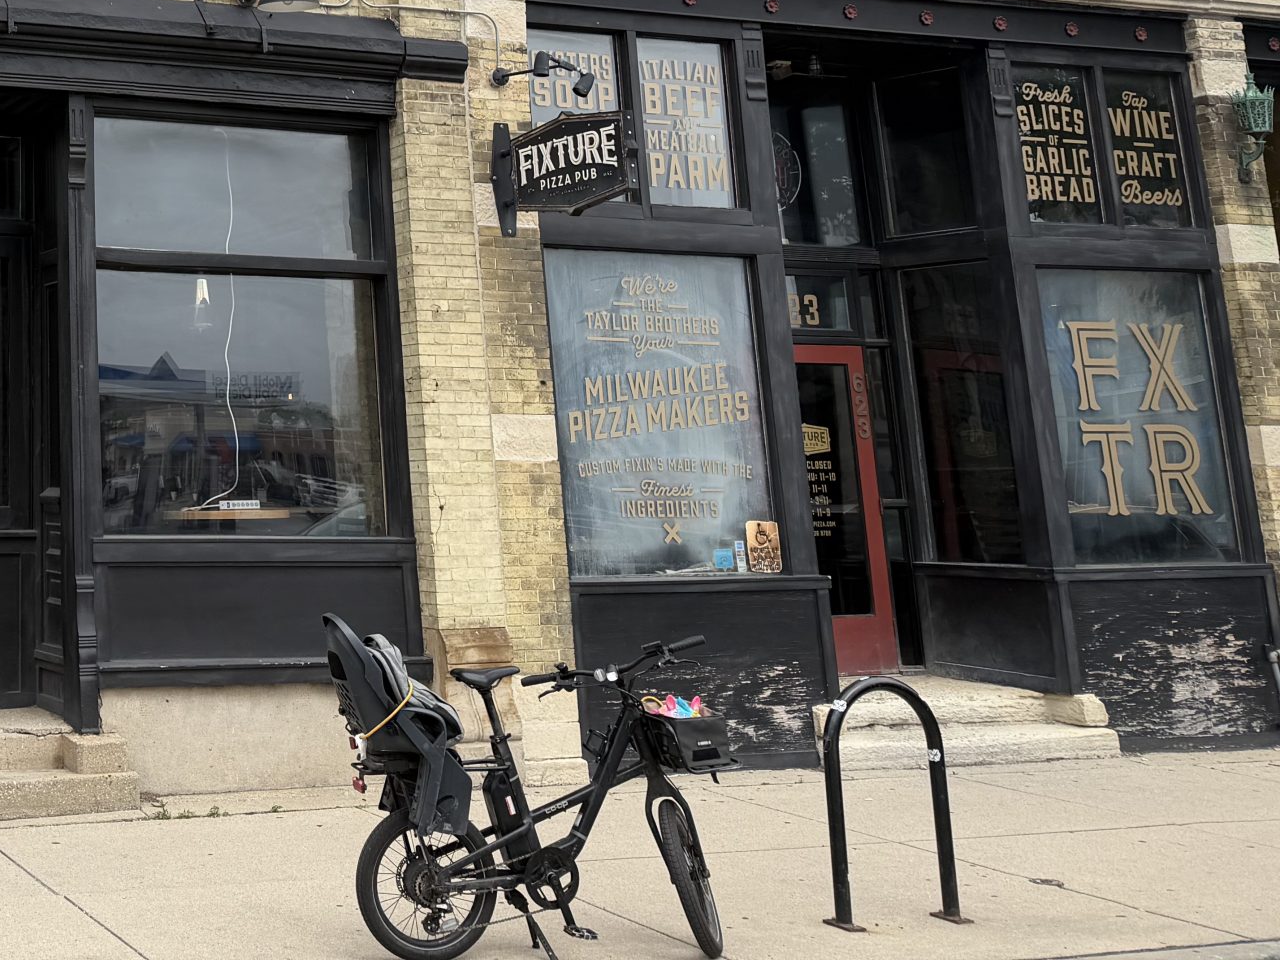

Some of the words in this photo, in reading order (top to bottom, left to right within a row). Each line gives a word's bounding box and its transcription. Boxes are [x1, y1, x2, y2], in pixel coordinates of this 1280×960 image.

[531, 50, 611, 80] STERS
[641, 59, 719, 85] ITALIAN
[643, 82, 720, 118] BEEF
[1022, 82, 1073, 104] Fresh
[1122, 91, 1148, 110] Tap
[1017, 104, 1084, 135] SLICES
[1107, 107, 1174, 140] WINE
[1049, 134, 1059, 146] OF
[518, 123, 618, 187] FIXTURE
[1022, 145, 1092, 176] GARLIC
[1113, 149, 1177, 179] CRAFT
[540, 173, 572, 191] PIZZA
[575, 167, 597, 183] PUB
[649, 152, 730, 191] PARM
[1025, 174, 1096, 203] BREAD
[1121, 179, 1183, 207] Beers
[621, 273, 678, 296] We're
[640, 298, 662, 313] THE
[585, 310, 639, 331] TAYLOR
[646, 315, 720, 335] BROTHERS
[633, 334, 673, 358] Your
[585, 362, 729, 406] MILWAUKEE
[568, 403, 641, 443] PIZZA
[646, 391, 750, 433] MAKERS
[578, 458, 621, 478] CUSTOM
[625, 457, 664, 473] FIXIN'S
[668, 457, 697, 473] MADE
[700, 458, 728, 477] WITH
[733, 463, 753, 479] THE
[806, 460, 832, 470] CLOSED
[641, 479, 695, 497] Finest
[621, 499, 720, 518] INGREDIENTS
